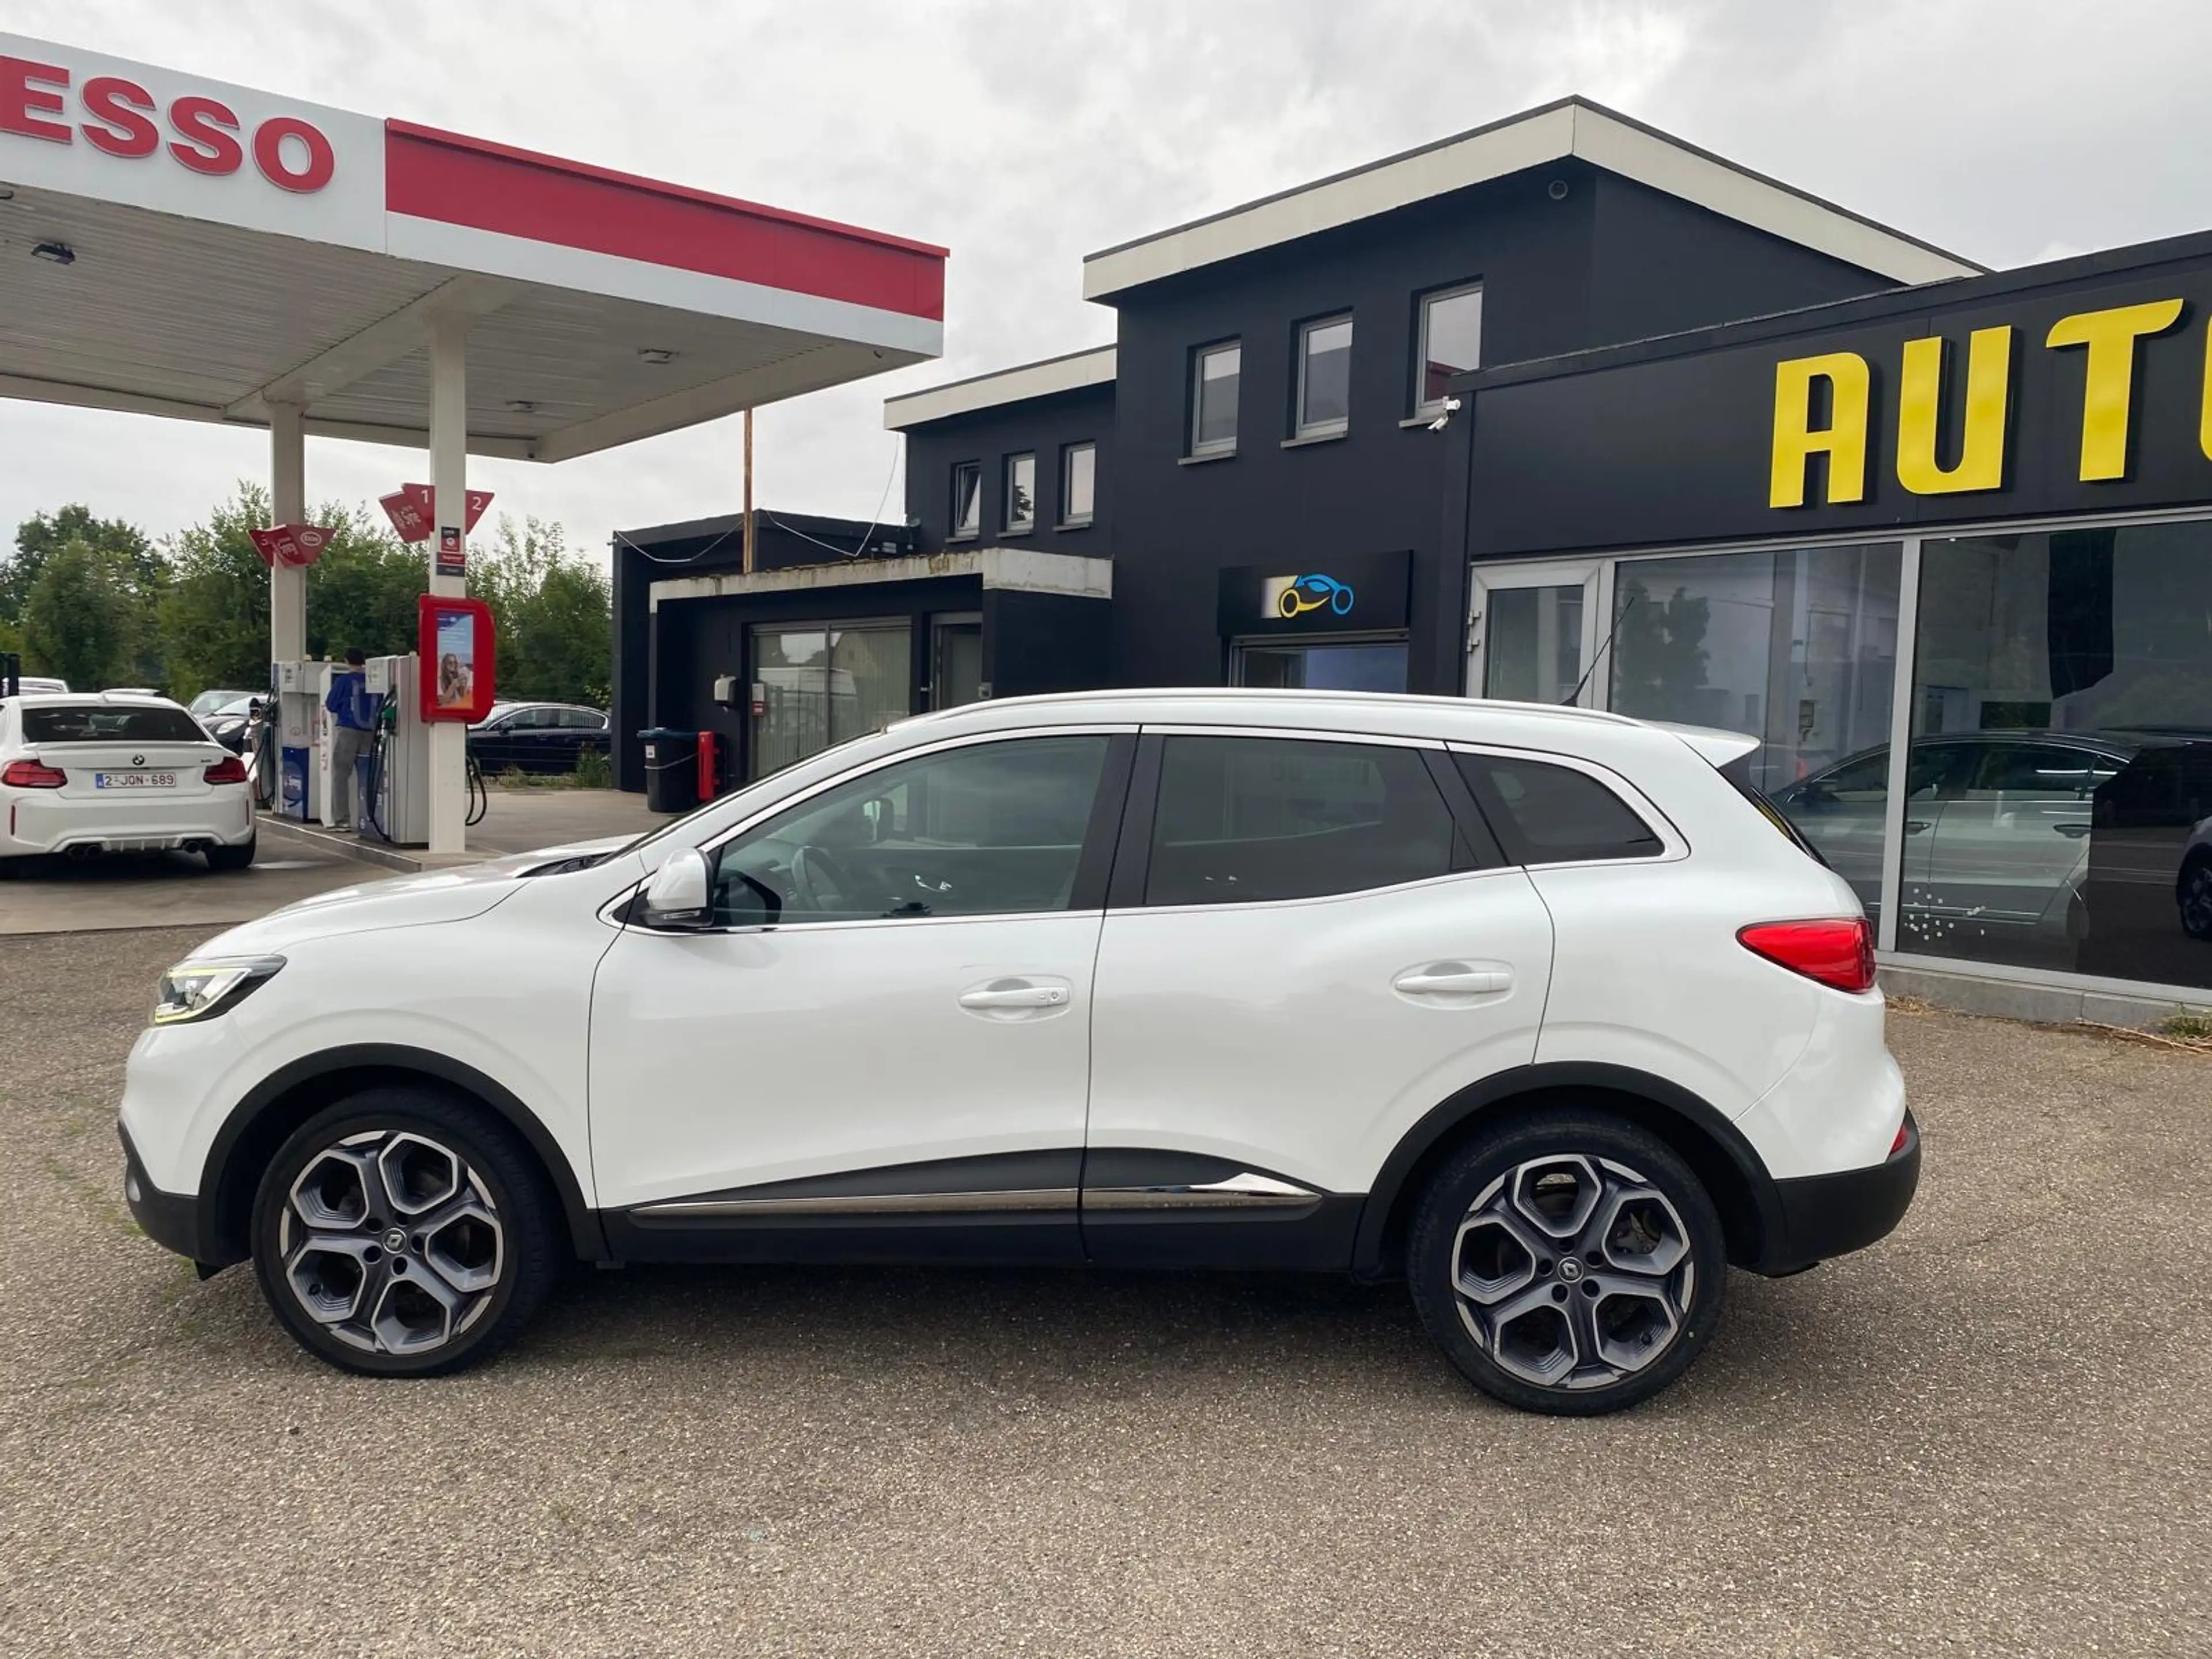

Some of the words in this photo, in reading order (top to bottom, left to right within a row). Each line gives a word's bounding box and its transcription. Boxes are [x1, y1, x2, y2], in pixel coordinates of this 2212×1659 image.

[0, 55, 335, 193] ESSO
[1770, 298, 2212, 508] AUT
[421, 489, 429, 504] 1
[472, 496, 482, 511] 2
